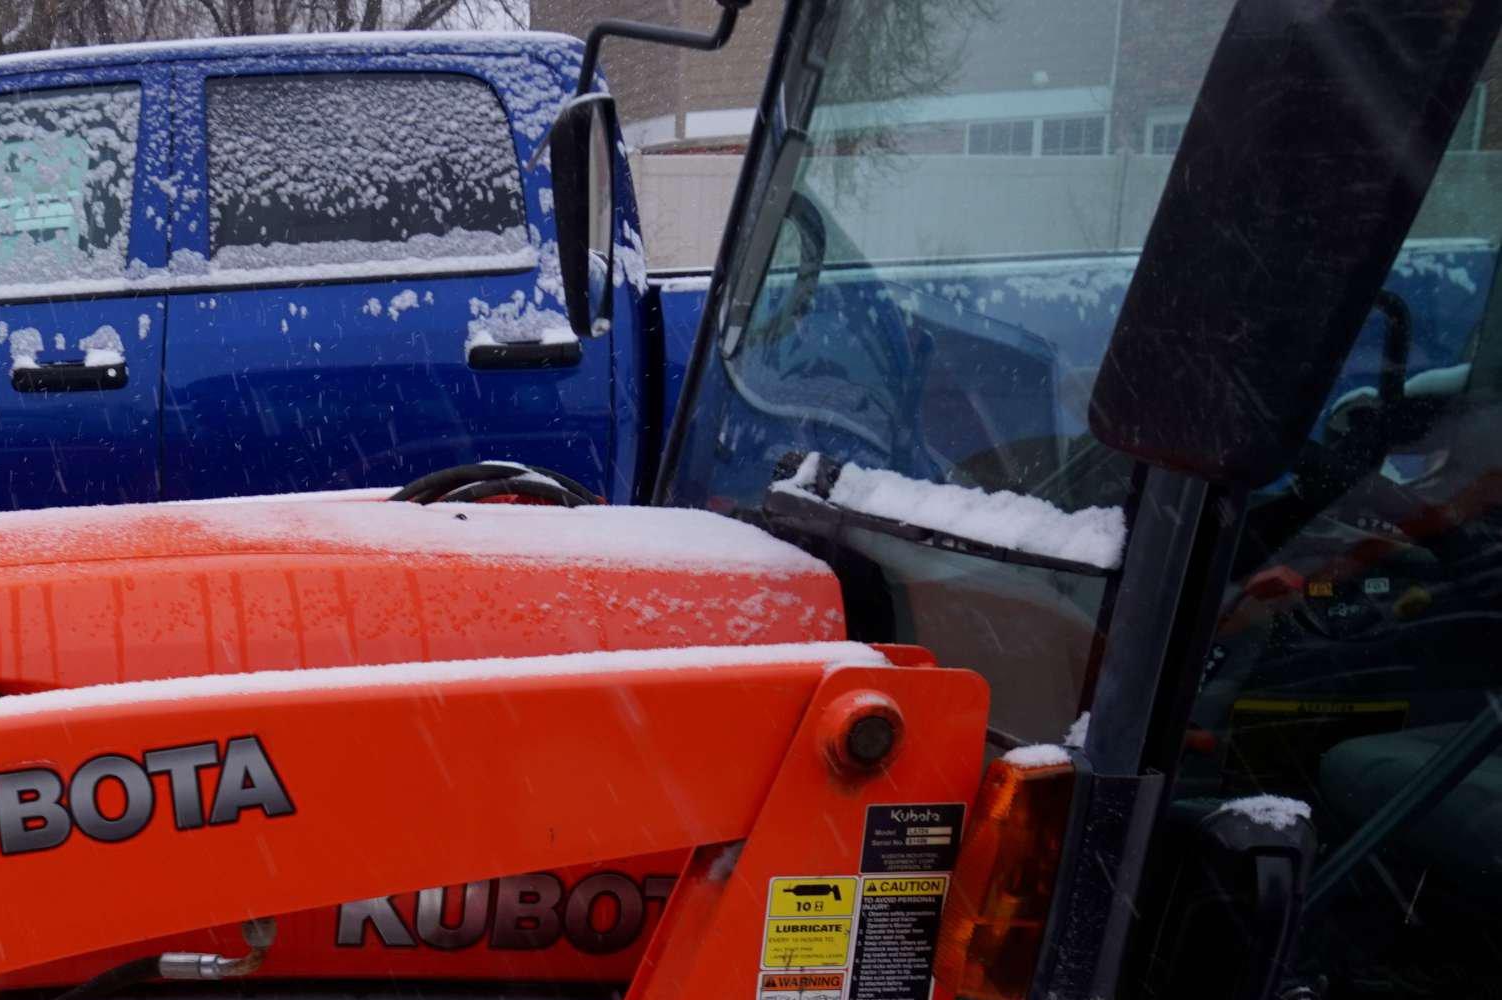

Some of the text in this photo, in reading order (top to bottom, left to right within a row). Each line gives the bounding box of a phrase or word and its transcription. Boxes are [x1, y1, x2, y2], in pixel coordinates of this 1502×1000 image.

[891, 809, 940, 822] Kubota
[880, 881, 940, 892] CAUTION
[796, 901, 811, 912] 10
[776, 924, 843, 933] LUBRICATE
[778, 976, 840, 987] WARNING
